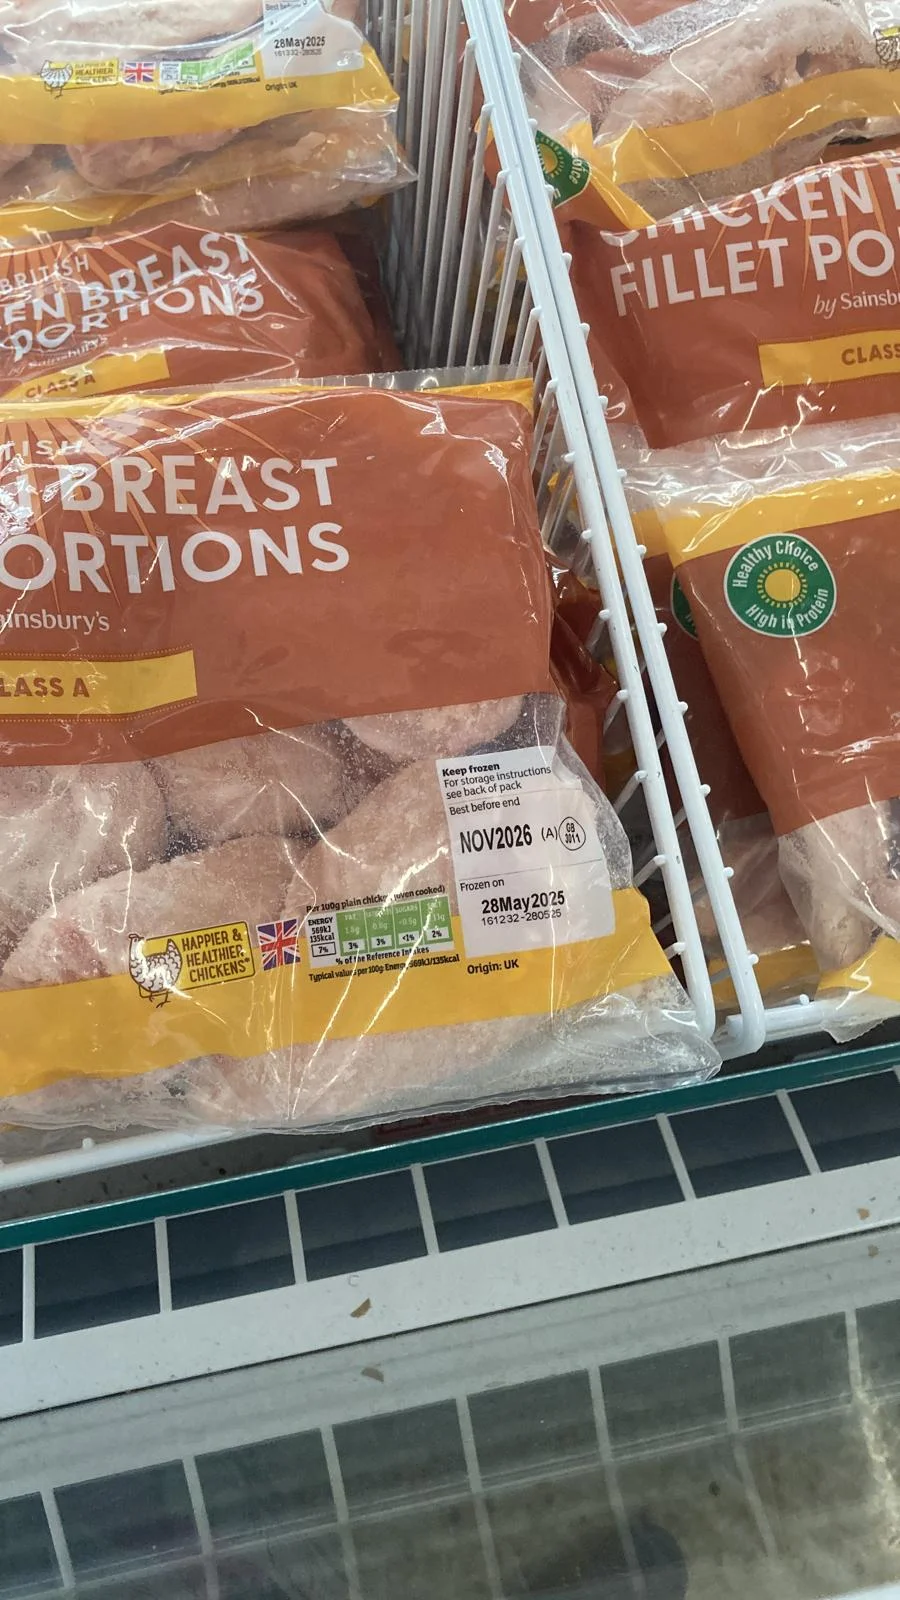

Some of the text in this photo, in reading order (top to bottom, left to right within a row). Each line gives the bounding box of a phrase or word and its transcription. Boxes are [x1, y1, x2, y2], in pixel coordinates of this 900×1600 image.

[274, 36, 326, 49] 28May2025
[0, 254, 90, 295] BRITISH
[0, 231, 254, 327] EN BREAST
[609, 222, 900, 317] FILLET PO
[813, 293, 838, 320] by
[11, 271, 265, 363] PORTIONS
[84, 373, 96, 385] A
[60, 456, 338, 516] BREAST
[0, 522, 350, 595] ORTIONS
[732, 544, 772, 588] Healthy
[745, 588, 829, 629] High in Protein
[72, 676, 90, 698] A
[442, 761, 500, 778] Keep frozen
[443, 765, 552, 788] For storage instructions
[446, 780, 523, 800] see back of pack
[449, 796, 521, 816] Best before end
[565, 822, 576, 833] GB
[459, 823, 558, 854] NOV2026 (A)
[459, 878, 505, 893] Frozen on
[320, 901, 341, 913] 100g
[341, 898, 363, 910] plain
[415, 884, 446, 897] cooked)
[481, 890, 565, 914] 28May2025
[395, 904, 418, 914] SUGARS
[481, 909, 562, 927] 161232-280525
[307, 916, 334, 927] ENERGY
[311, 926, 332, 935] 569kJ
[181, 927, 243, 952] HAPPIER &
[309, 932, 335, 943] 135kcal
[376, 937, 387, 947] 3%
[402, 933, 415, 942] <1%
[431, 929, 443, 938] 2%
[318, 945, 329, 954] 7%
[348, 941, 359, 950] 3%
[185, 944, 245, 968] HEALTHIER
[335, 957, 343, 966] %
[344, 955, 353, 965] of
[366, 949, 401, 962] Reference
[308, 970, 335, 983] Typical
[356, 966, 368, 977] per
[467, 958, 520, 976] Origin: UK
